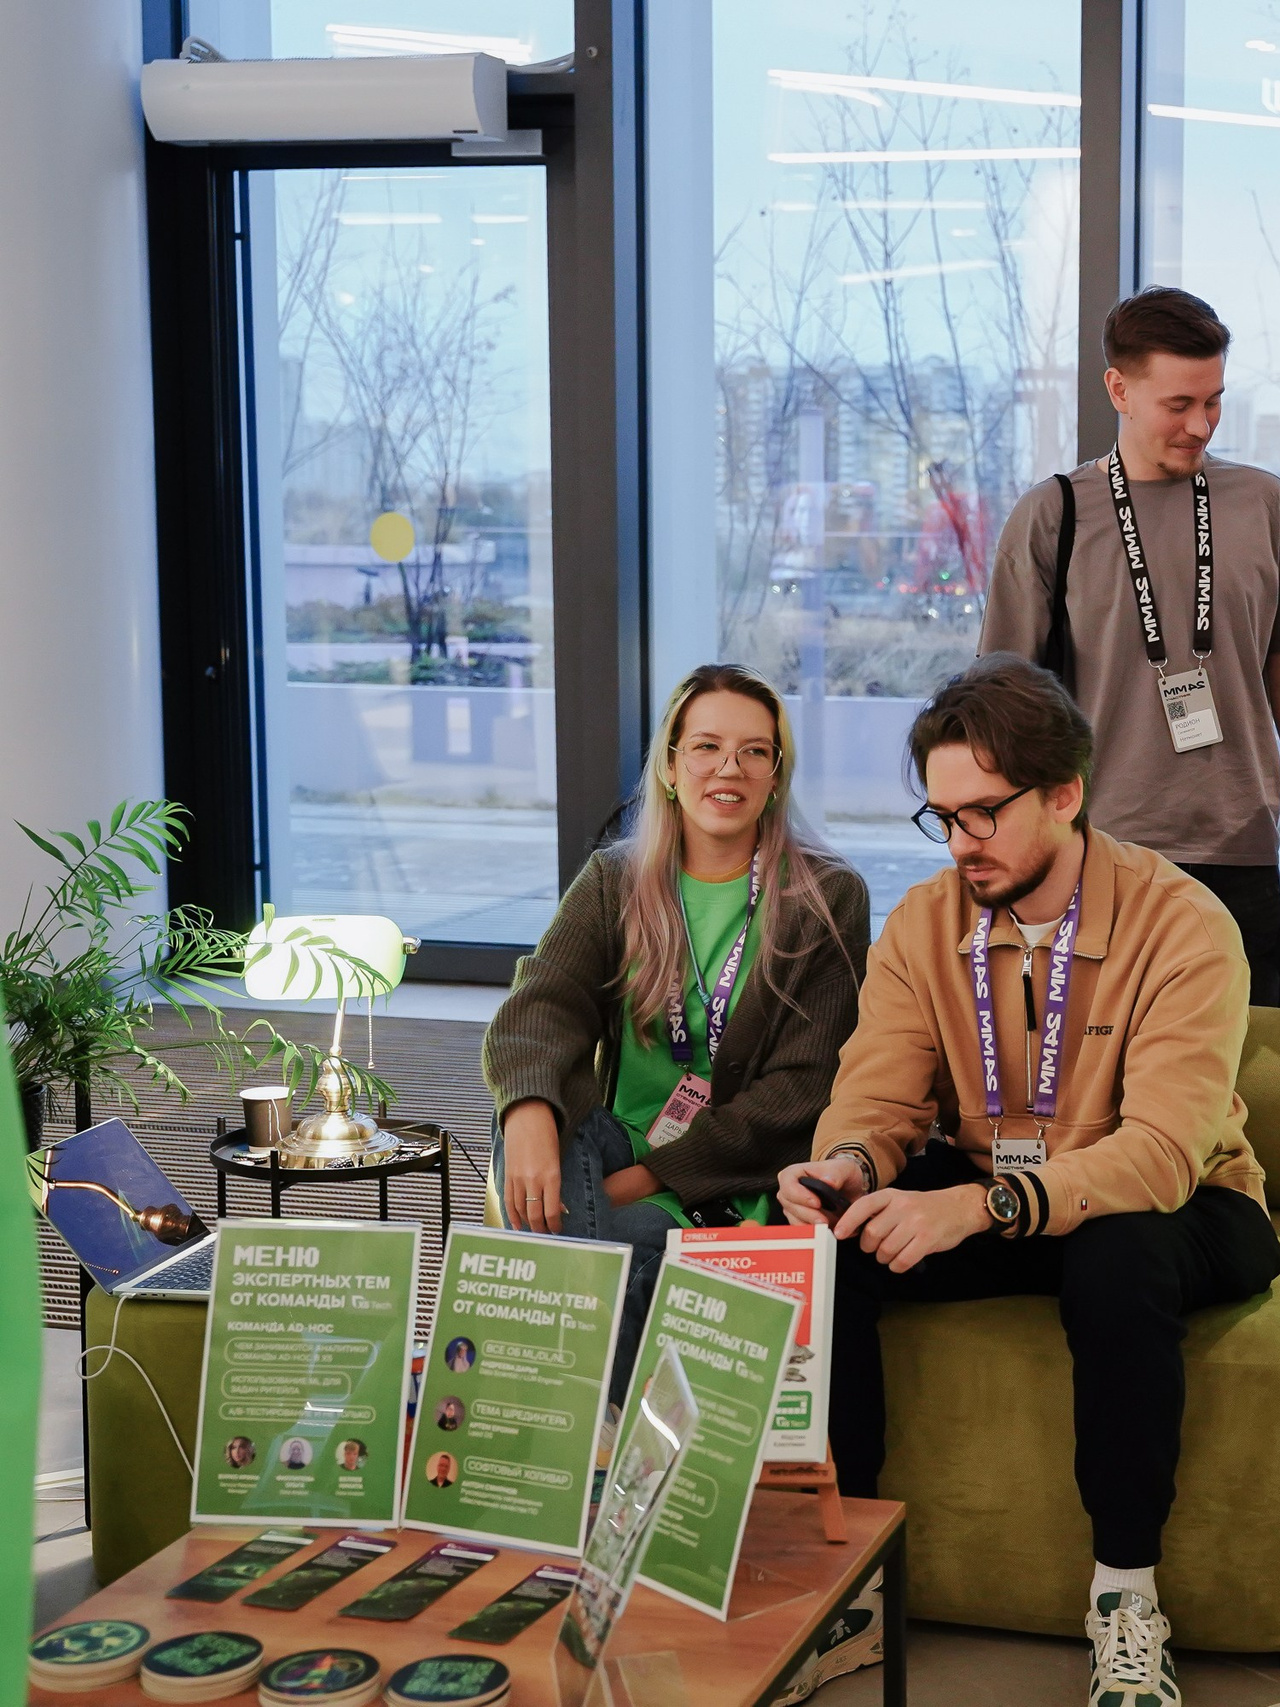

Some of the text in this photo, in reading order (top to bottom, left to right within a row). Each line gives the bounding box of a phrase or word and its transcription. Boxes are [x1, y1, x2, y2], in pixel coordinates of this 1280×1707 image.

[233, 1245, 320, 1268] МЕНЮ
[459, 1252, 536, 1281] МЕНЮ
[232, 1272, 391, 1290] ЭКСПЕРТНЫХ ТЕМ
[230, 1292, 253, 1306] ОТ
[257, 1294, 345, 1310] КОМАНДЫ
[456, 1279, 598, 1311] ЭКСПЕРТНЫХ ТЕМ
[666, 1284, 727, 1323] МЕНЮ
[453, 1300, 474, 1313] ОТ
[475, 1302, 555, 1327] КОМАНДЫ
[227, 1321, 285, 1333] КОМАНДА
[661, 1312, 769, 1361] ЭКСПЕРТНЫХ ТЕМ
[486, 1343, 505, 1355] ВСЕ
[675, 1338, 734, 1372] КОМАНДЫ
[475, 1403, 568, 1427] ТЕМА ШРЕДИНГЕРА
[468, 1460, 569, 1484] СОФТОВЫЙ ХОЛИВАР
